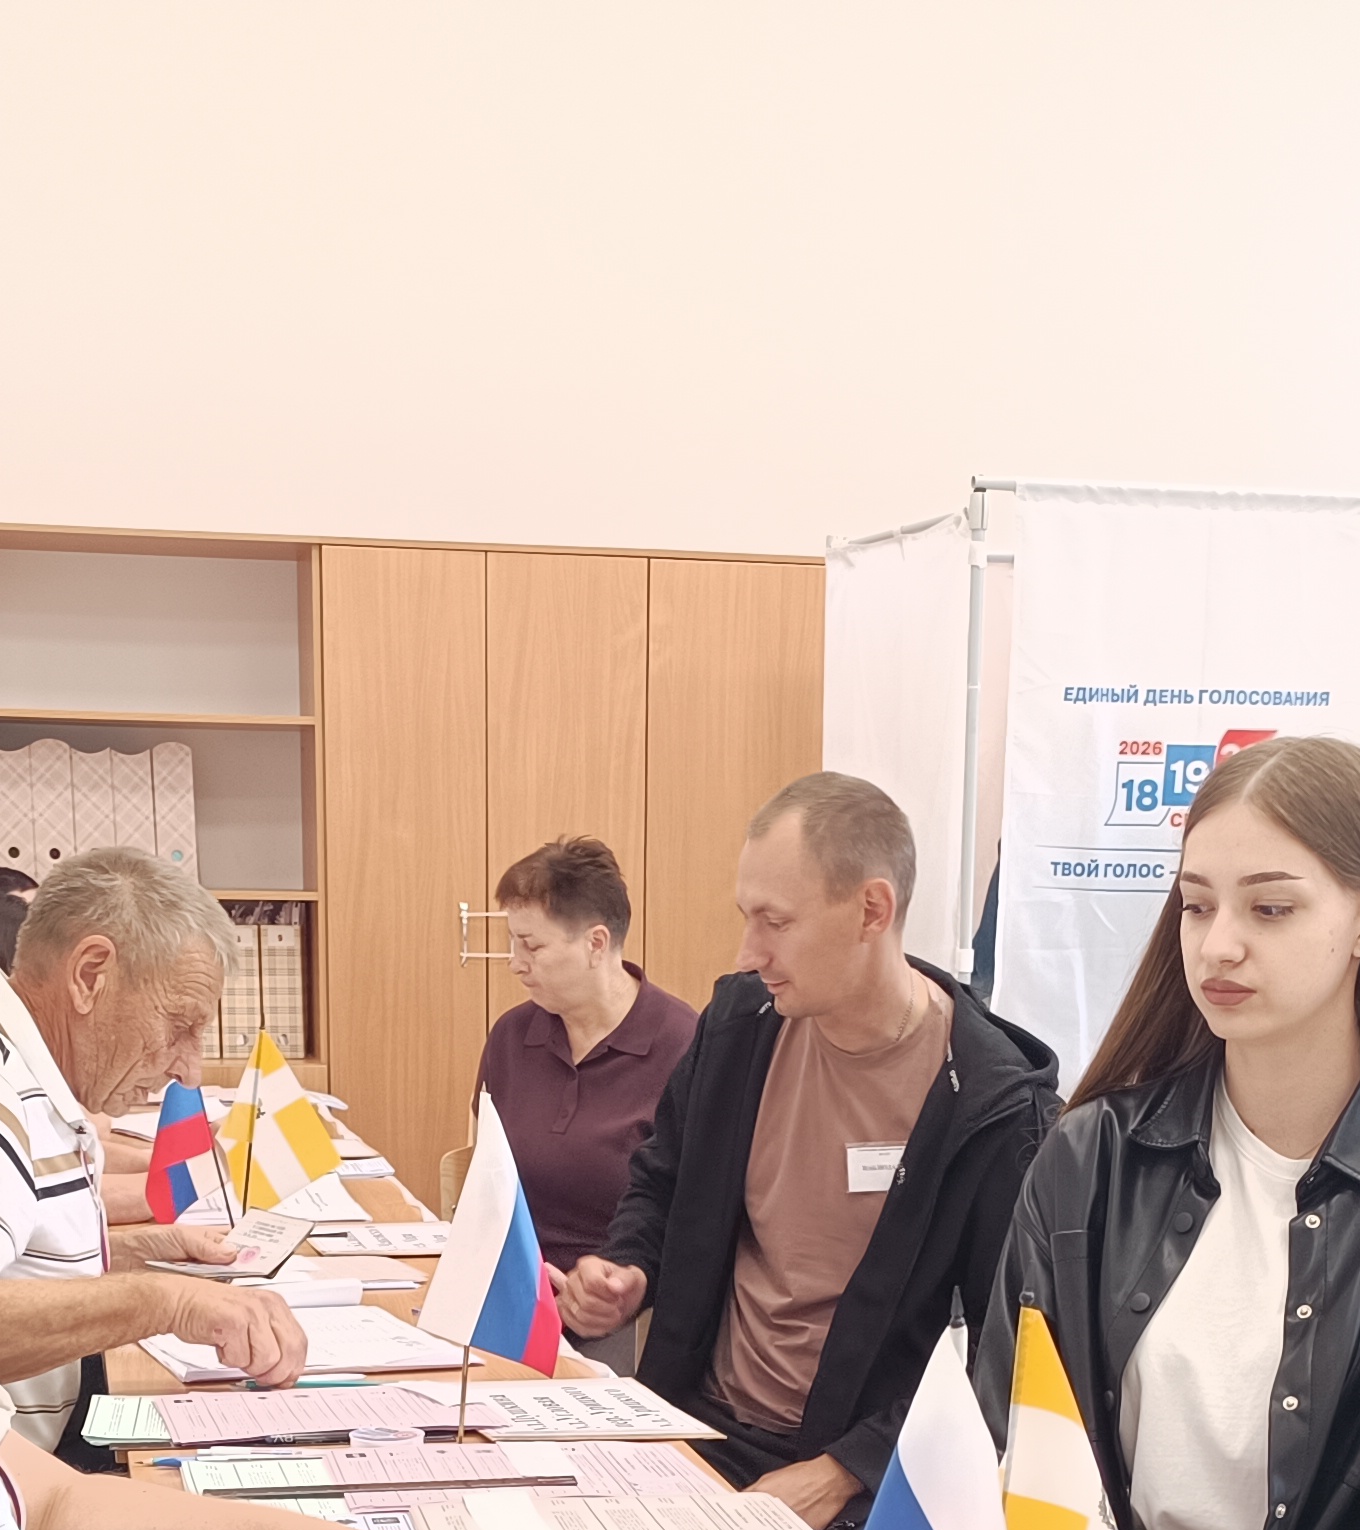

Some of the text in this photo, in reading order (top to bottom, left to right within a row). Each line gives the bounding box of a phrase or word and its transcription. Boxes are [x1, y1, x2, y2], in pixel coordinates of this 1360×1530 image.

[1063, 685, 1330, 707] ЕДИНЫЙ ДЕНЬ ГОЛОСОВАНИЯ
[1118, 741, 1163, 756] 2026
[1121, 779, 1158, 812] 18
[1050, 859, 1099, 877] ТВОЙ
[1104, 863, 1165, 878] ГОЛОС
